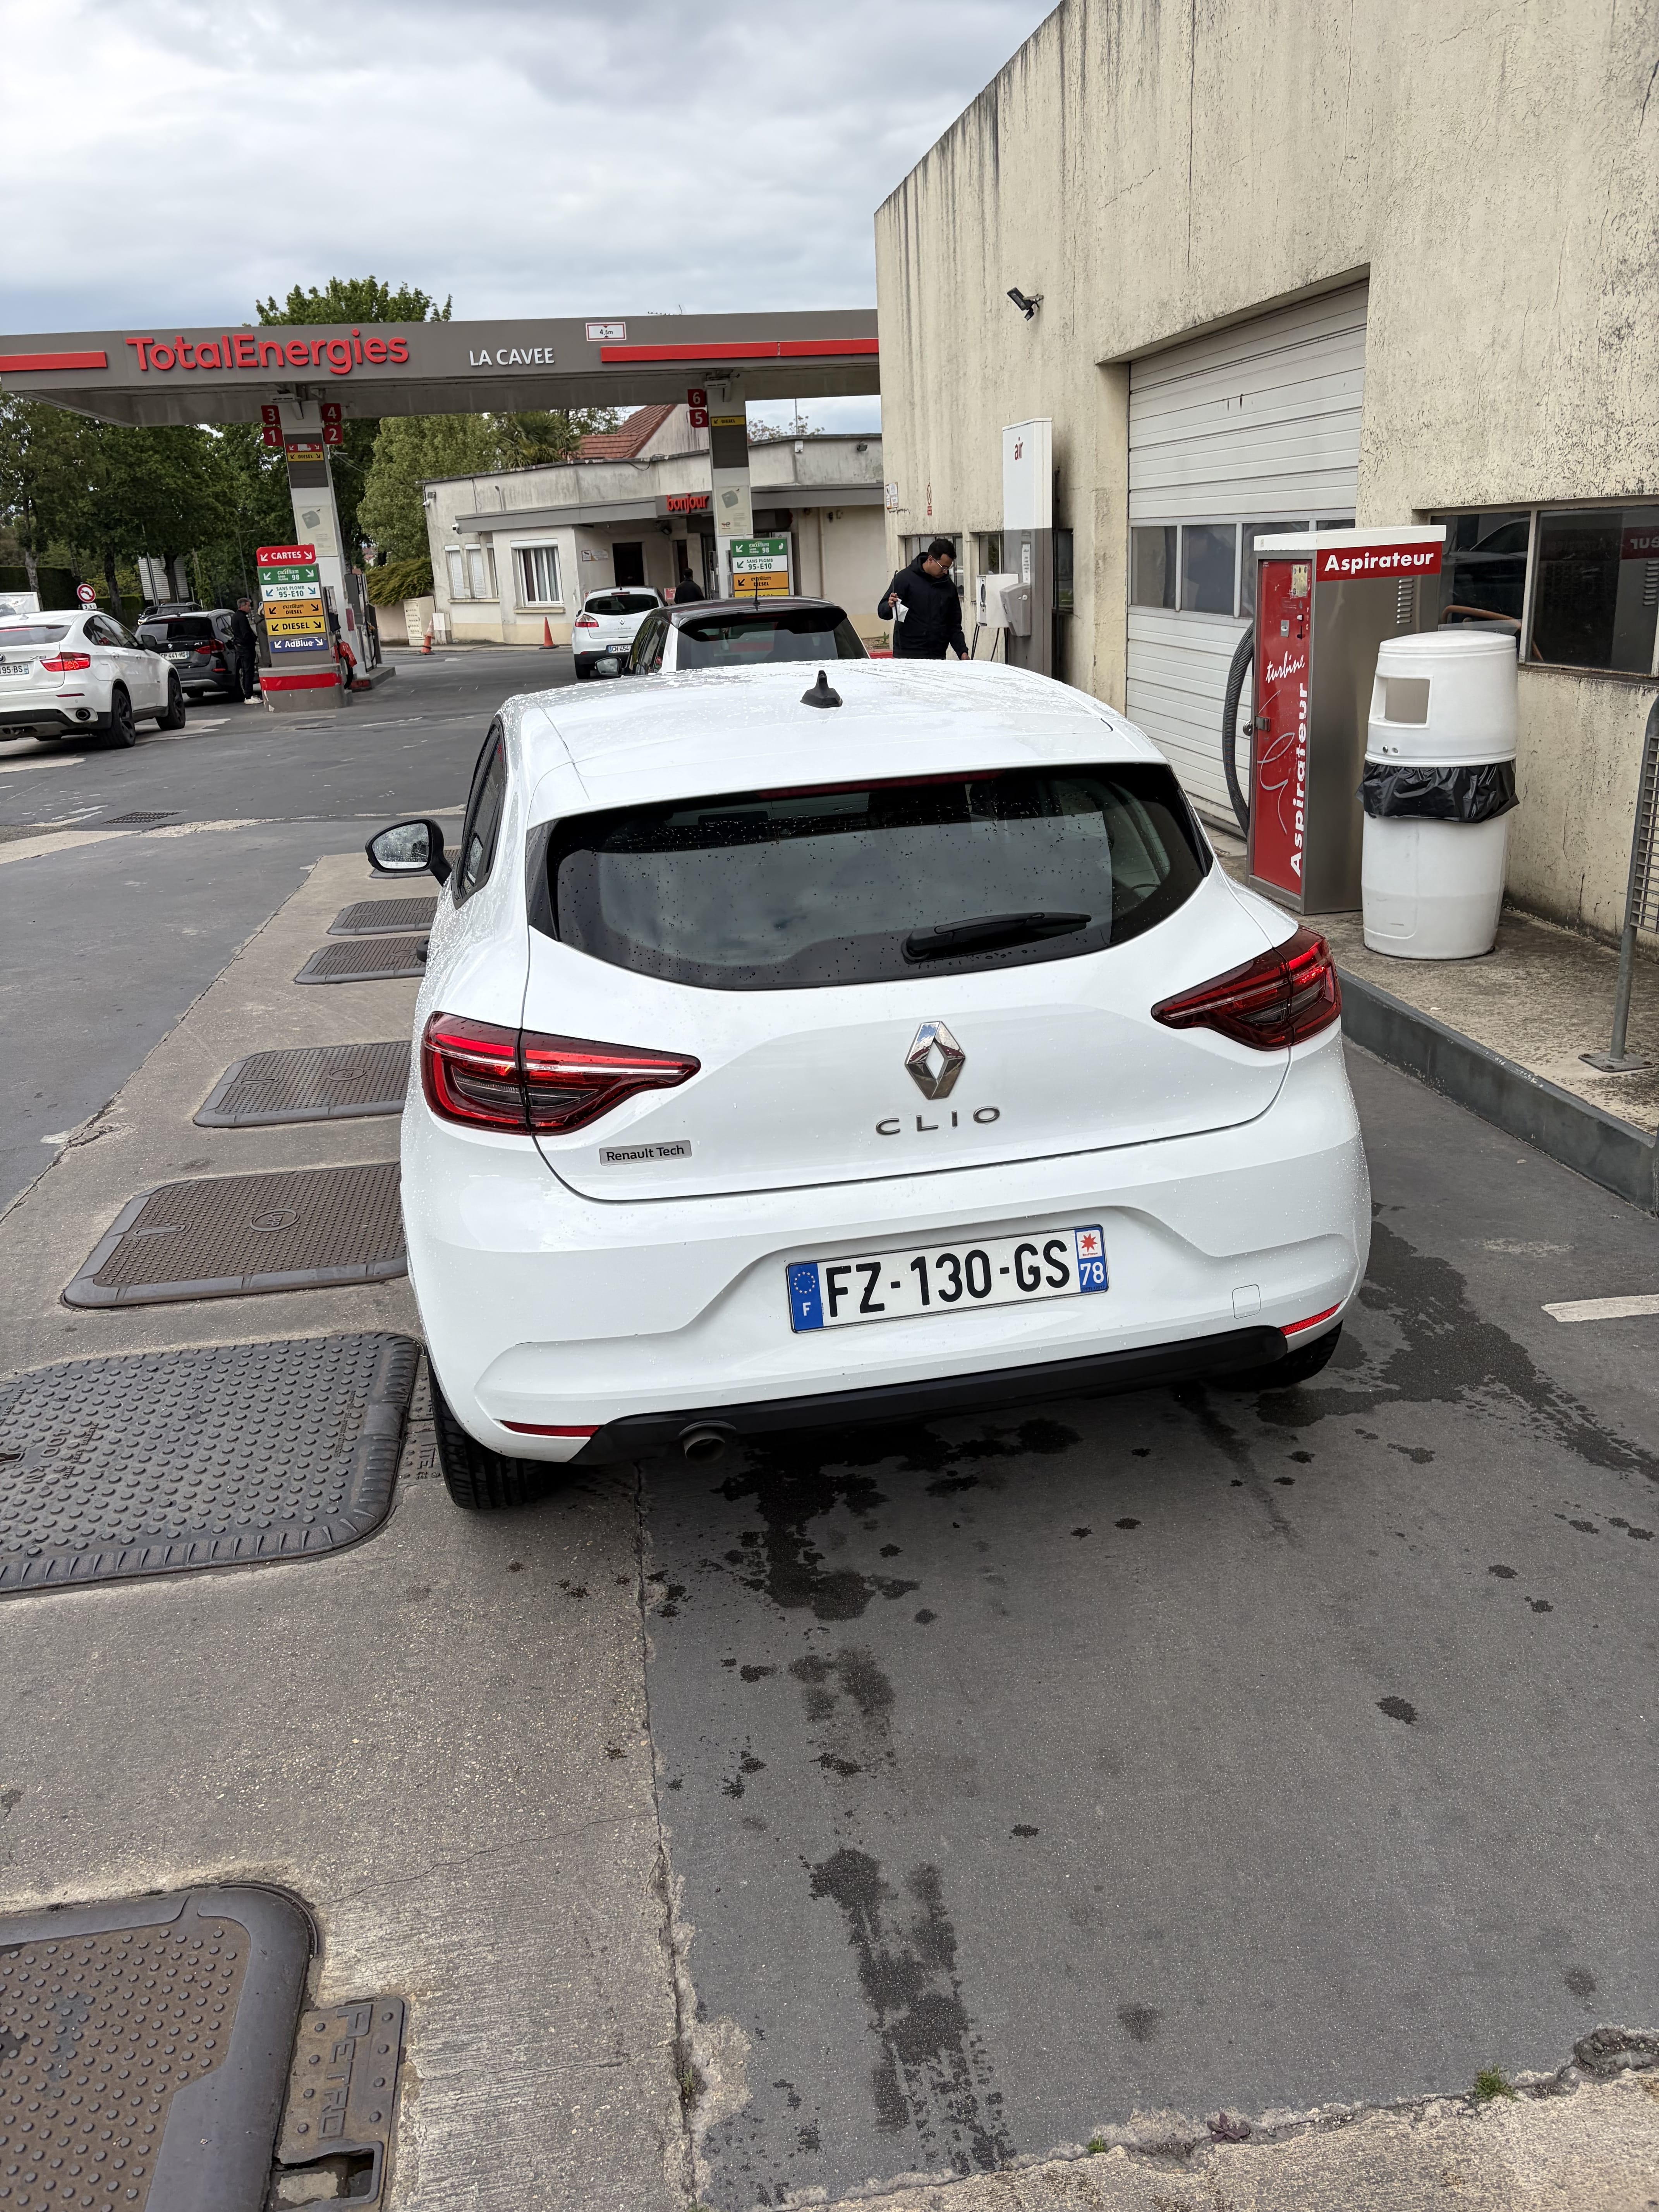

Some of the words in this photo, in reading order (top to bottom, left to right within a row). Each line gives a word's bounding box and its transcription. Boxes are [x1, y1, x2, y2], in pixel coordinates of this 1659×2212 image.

[125, 328, 409, 374] TotalEnergies
[469, 350, 492, 366] LA
[496, 348, 555, 365] CAVEE
[693, 392, 701, 404] 6
[267, 409, 276, 421] 3
[328, 407, 337, 419] 4
[696, 412, 703, 424] 5
[269, 430, 276, 443] 1
[329, 428, 338, 441] 2
[1015, 437, 1023, 460] air
[666, 493, 709, 514] bonjour
[271, 551, 302, 560] CARTES
[1324, 552, 1434, 574] Aspirateur
[285, 639, 314, 648] AdBlue
[1265, 651, 1305, 683] turbine
[1290, 682, 1307, 878] Aspirateur
[875, 1106, 1000, 1136] CLIO
[606, 1147, 654, 1163] Renault
[657, 1144, 685, 1156] Tech
[825, 1239, 1070, 1317] FZ-130-GS
[1080, 1262, 1104, 1286] 78
[802, 1302, 811, 1316] F
[40, 1427, 71, 1458] 400
[318, 2003, 373, 2139] PETRO
